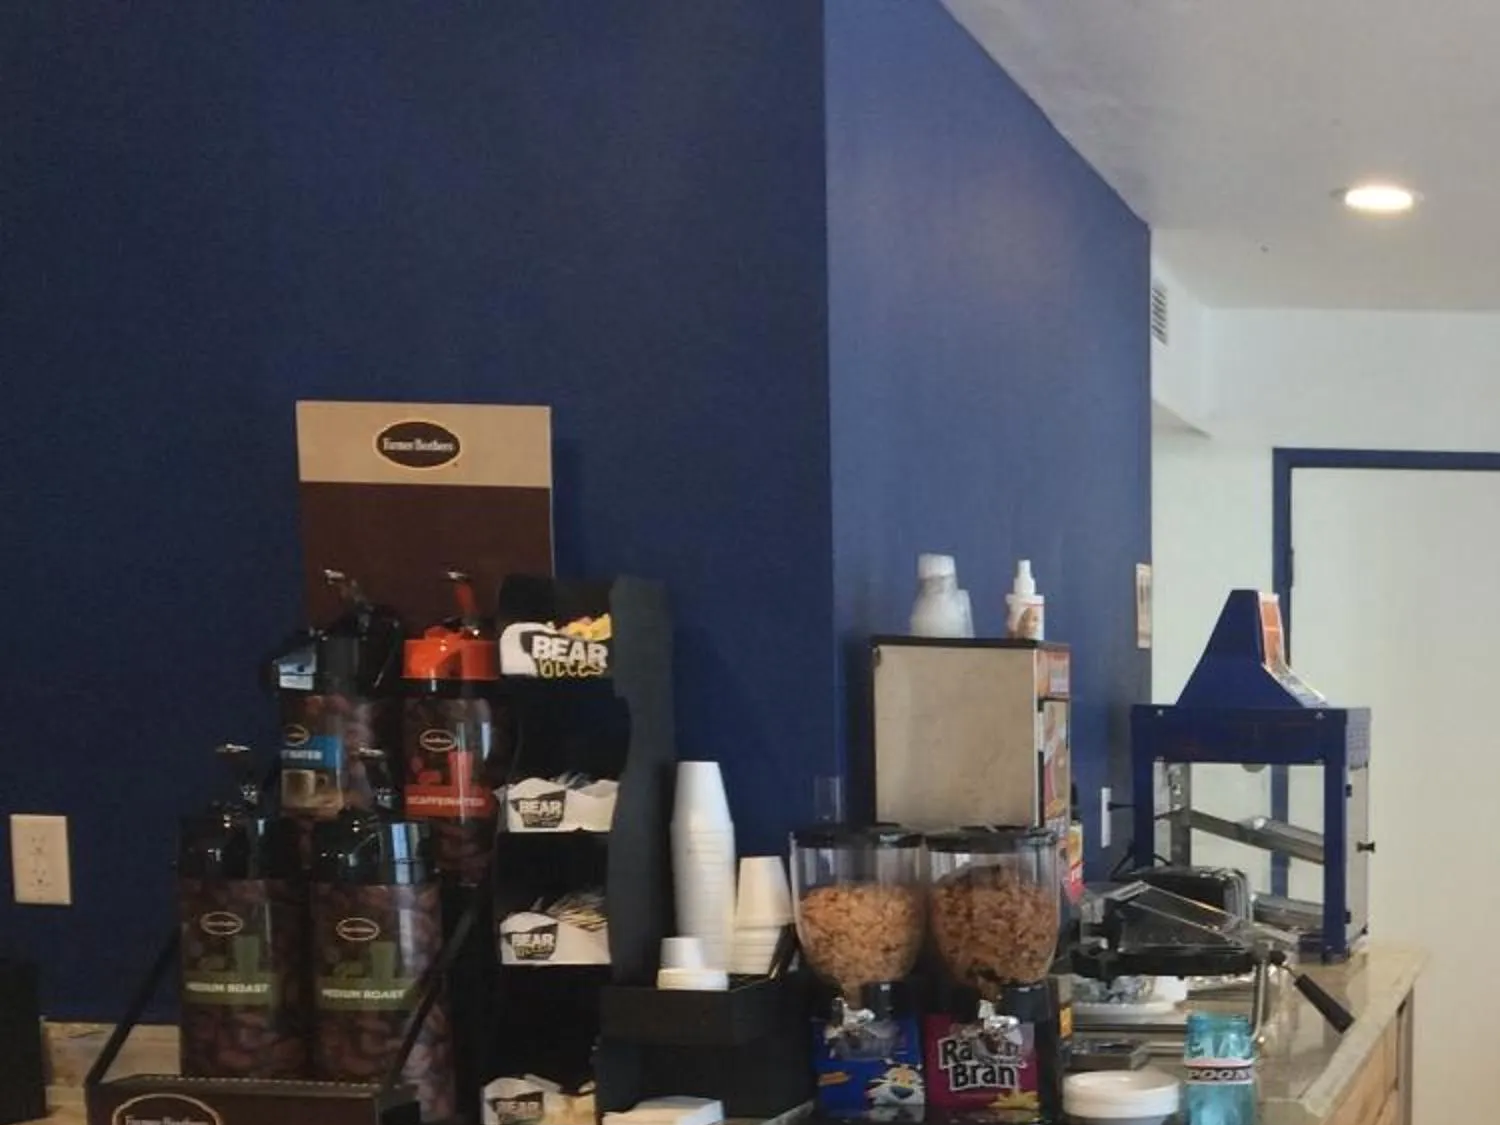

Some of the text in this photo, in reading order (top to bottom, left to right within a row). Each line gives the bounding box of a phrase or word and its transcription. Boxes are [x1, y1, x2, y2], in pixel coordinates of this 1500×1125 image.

[532, 635, 608, 669] BEAR
[519, 799, 563, 816] BEAR
[511, 933, 555, 949] BEAR
[227, 983, 269, 993] ROAST
[363, 989, 406, 1000] ROAST
[940, 1037, 1019, 1064] Ran
[952, 1061, 1016, 1088] Bran
[1183, 1068, 1252, 1082] POON
